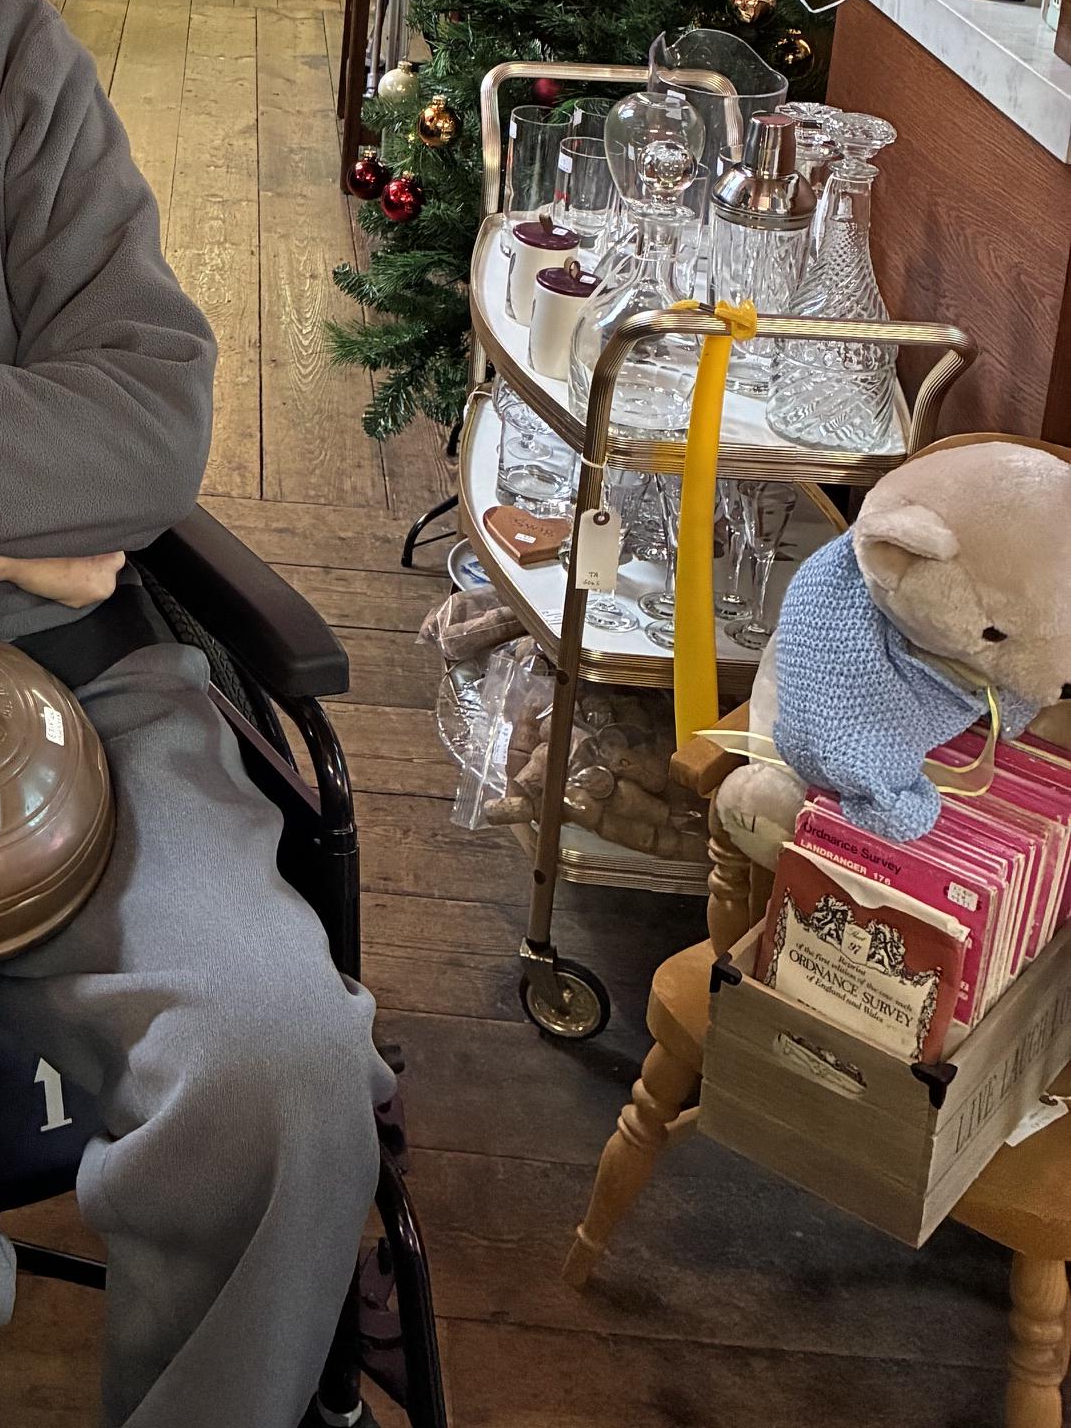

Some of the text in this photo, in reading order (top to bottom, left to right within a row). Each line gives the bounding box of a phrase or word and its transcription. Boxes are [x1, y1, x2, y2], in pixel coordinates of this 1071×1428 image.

[800, 839, 867, 875] LANDRANGER
[803, 823, 902, 876] Ordnance Survey
[796, 942, 805, 951] of
[804, 946, 815, 957] the
[814, 951, 830, 965] first
[831, 962, 857, 981] edition
[857, 977, 867, 986] of
[866, 980, 879, 993] the
[838, 956, 867, 976] Reprint
[847, 941, 862, 956] 97
[789, 949, 859, 998] ORDNANCE
[861, 991, 914, 1028] SURVEY
[806, 974, 815, 983] of
[814, 977, 847, 1002] England
[846, 997, 862, 1011] and
[863, 1005, 884, 1024] Wales
[33, 1057, 73, 1133] 1
[954, 1074, 998, 1155] LIVE
